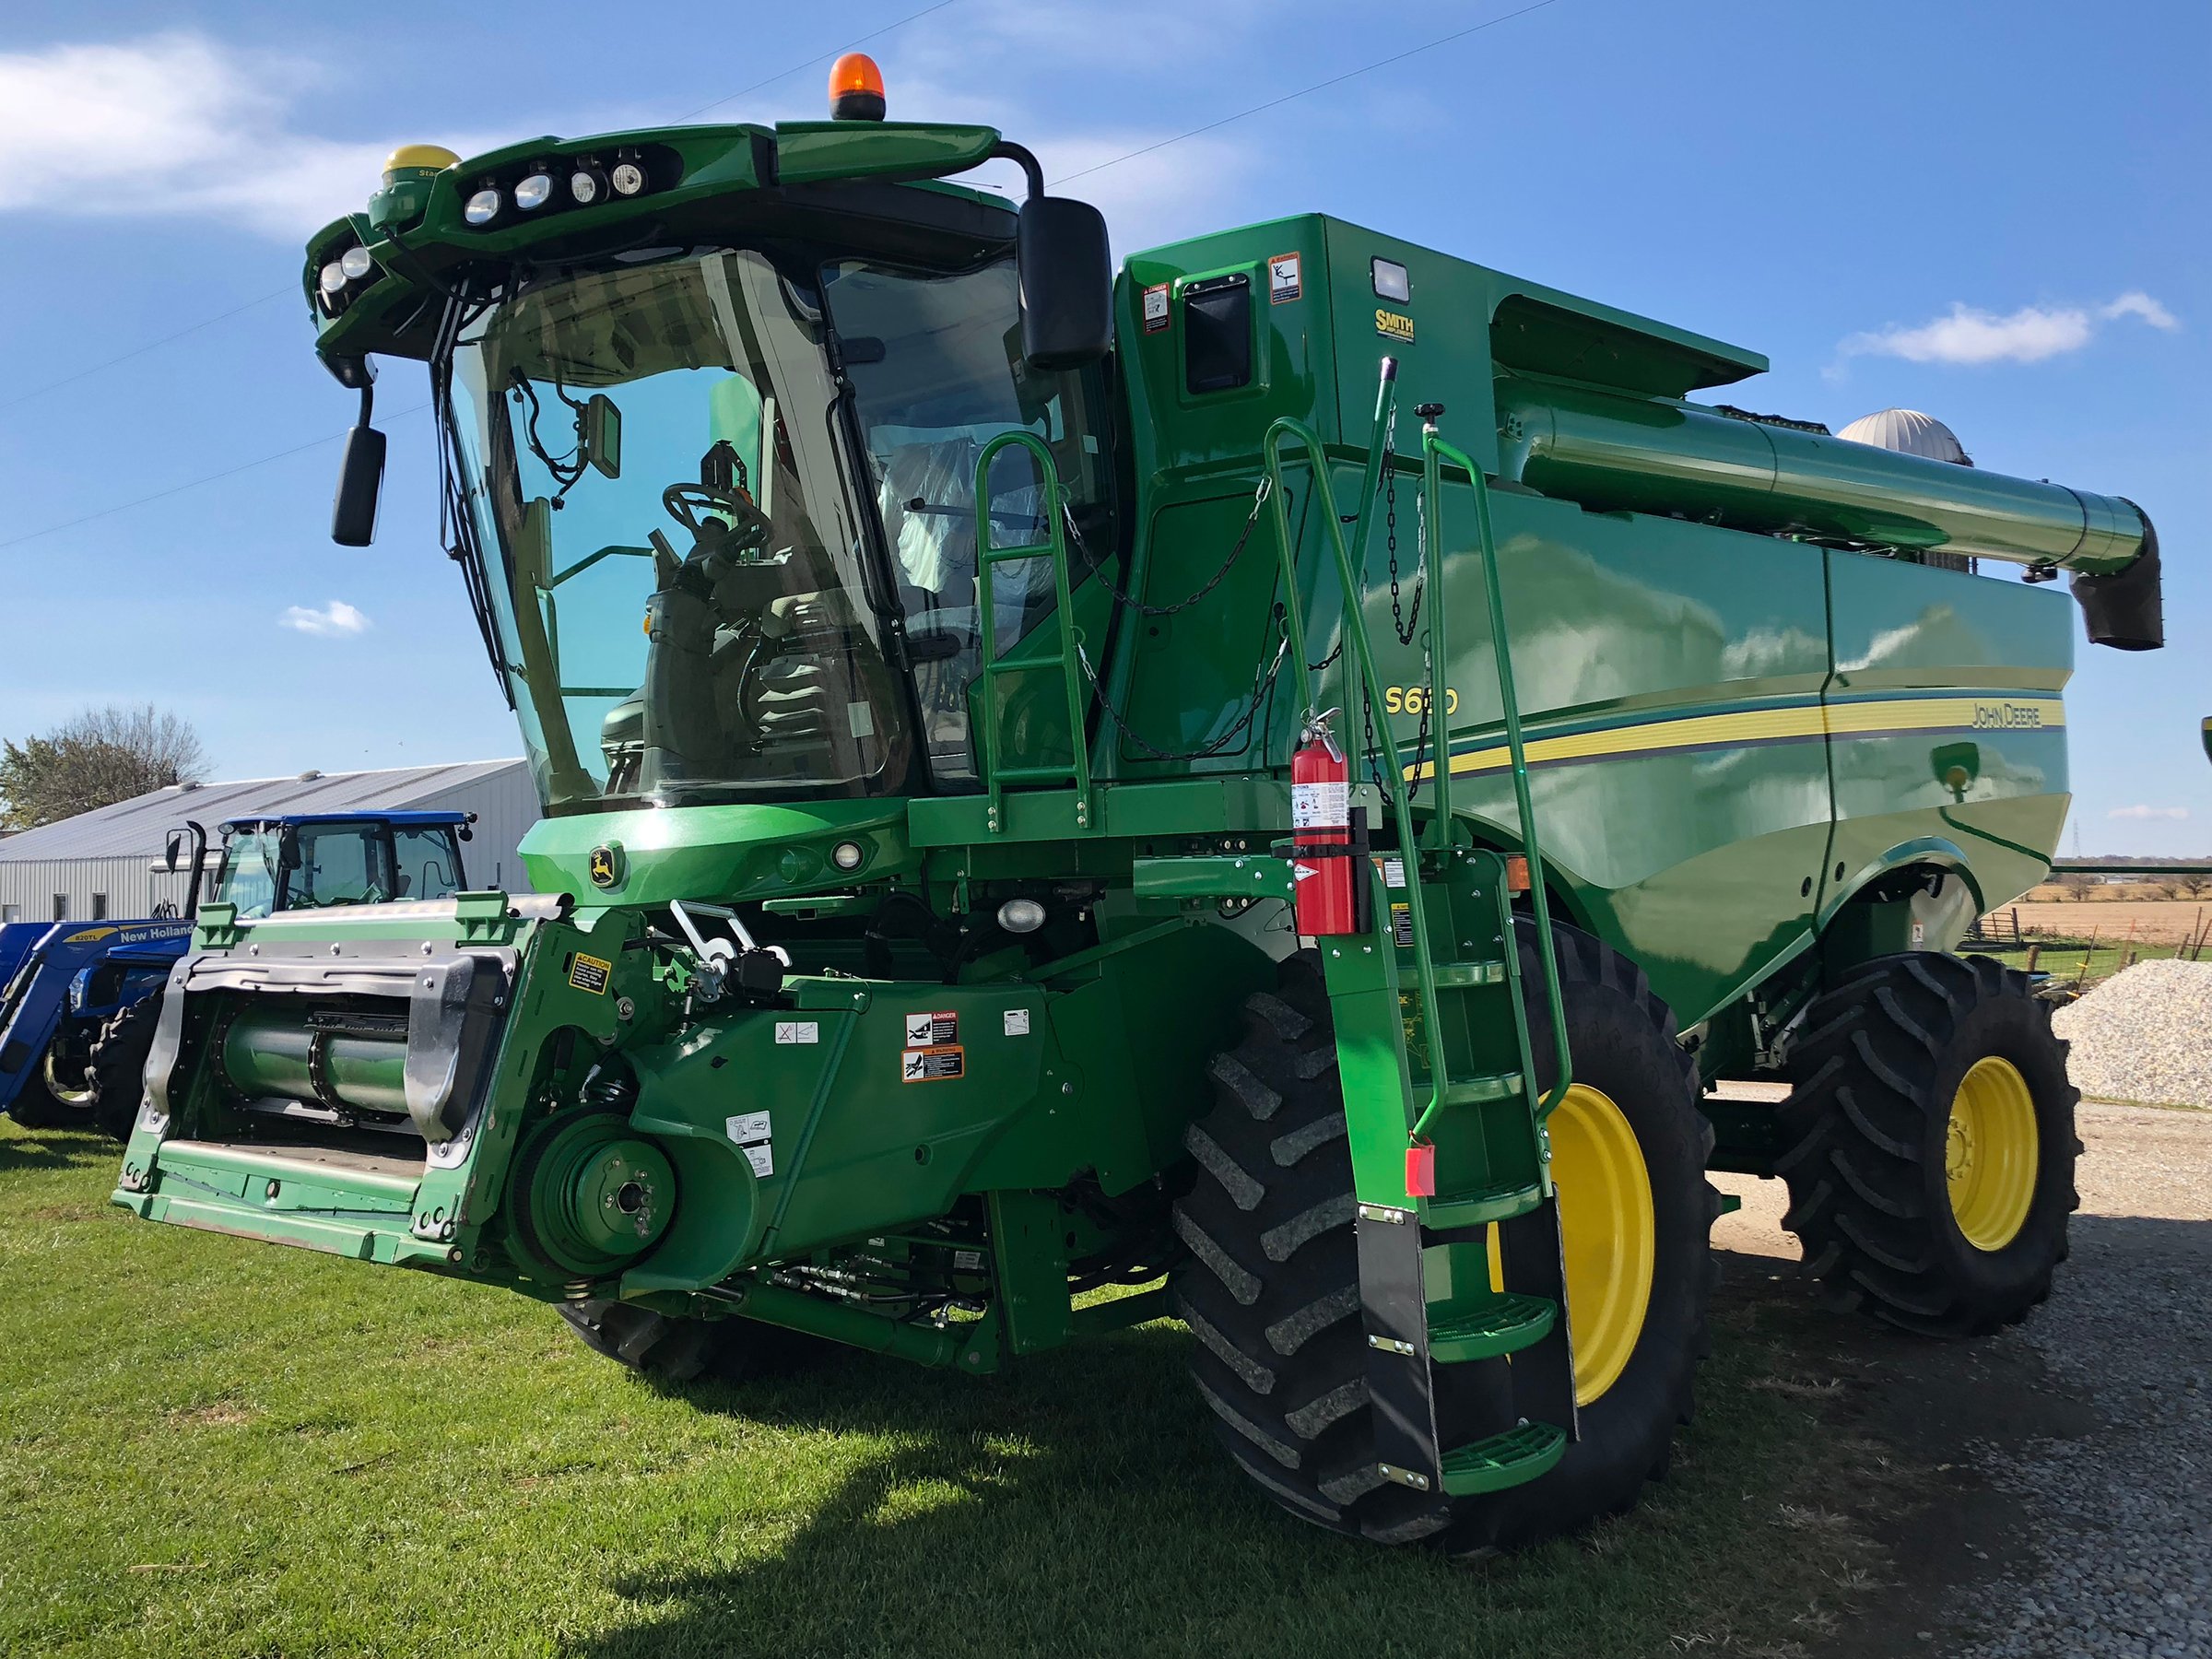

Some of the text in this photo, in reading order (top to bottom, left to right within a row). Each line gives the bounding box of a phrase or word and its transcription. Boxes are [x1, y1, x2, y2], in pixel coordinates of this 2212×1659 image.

[1375, 309, 1414, 333] SMITH
[1972, 703, 2041, 725] JOHN DEERE
[120, 924, 194, 944] New Holland
[582, 955, 610, 969] CAUTION
